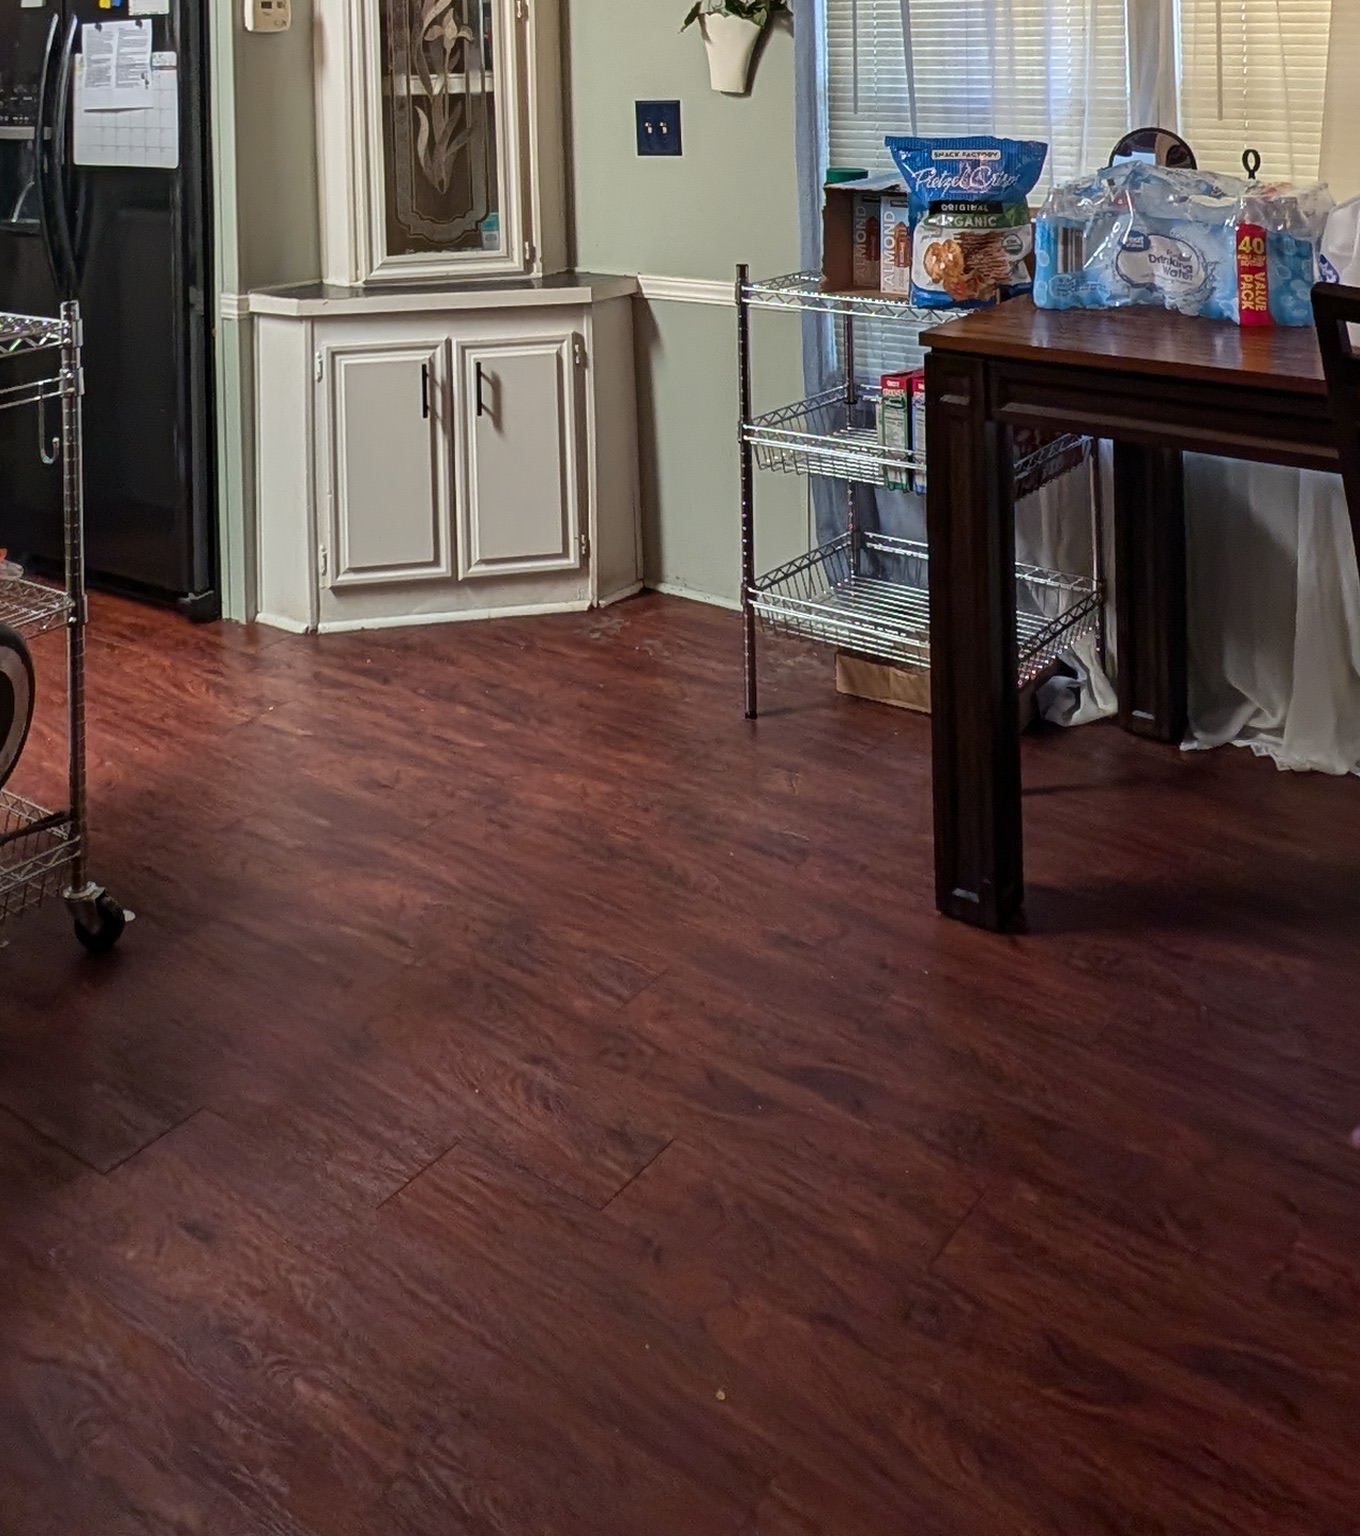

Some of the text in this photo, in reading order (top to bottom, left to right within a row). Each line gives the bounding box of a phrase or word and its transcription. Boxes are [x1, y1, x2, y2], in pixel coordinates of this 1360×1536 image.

[940, 202, 989, 212] ORIGINAL
[883, 210, 896, 285] ALMOND
[1238, 235, 1265, 255] 40
[1148, 253, 1193, 274] Drinking
[1162, 264, 1194, 281] Water
[1240, 273, 1255, 311] PACK
[1254, 271, 1267, 312] VALUE
